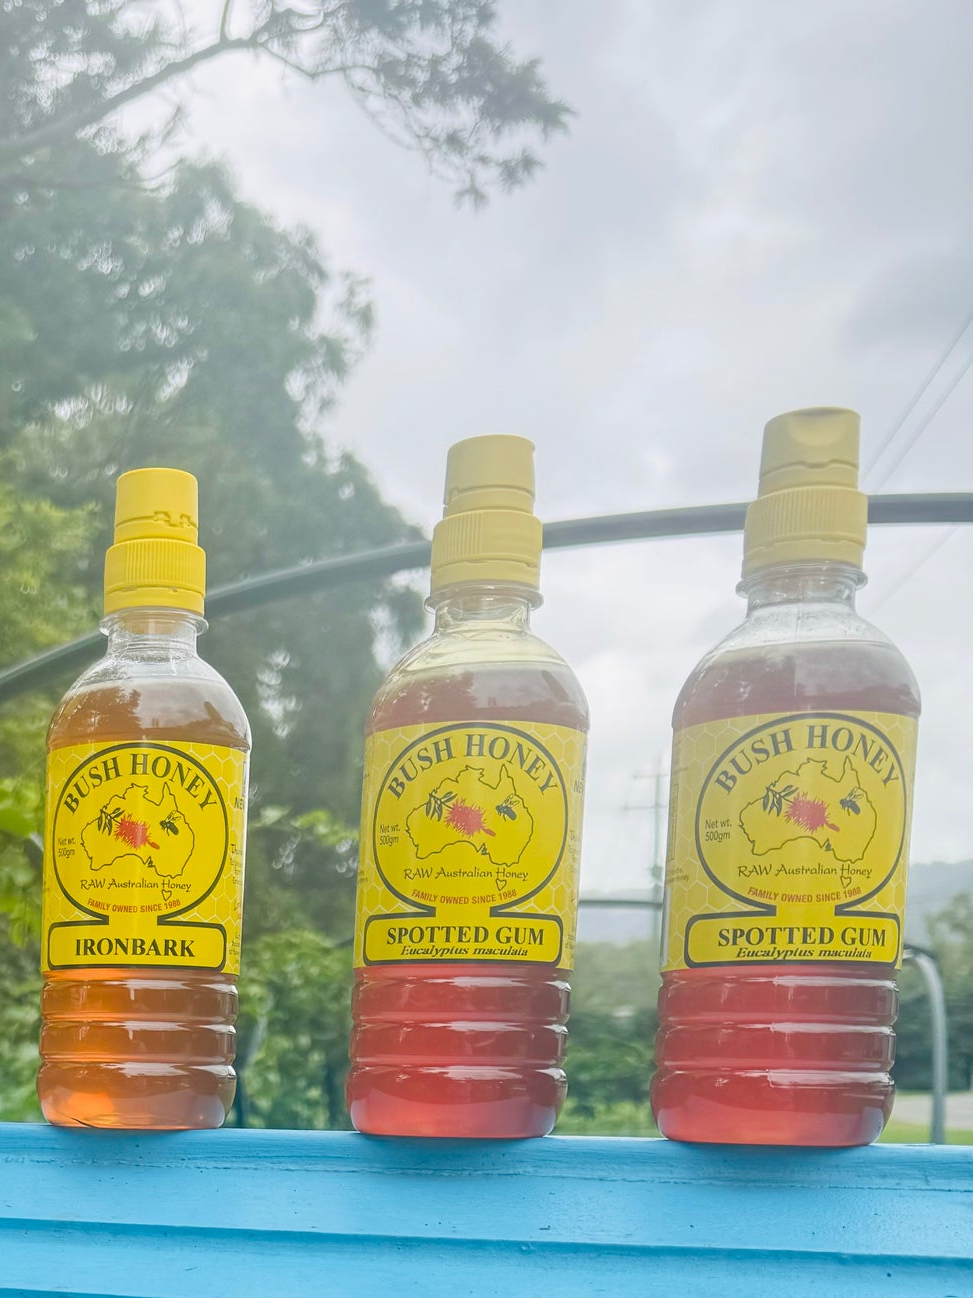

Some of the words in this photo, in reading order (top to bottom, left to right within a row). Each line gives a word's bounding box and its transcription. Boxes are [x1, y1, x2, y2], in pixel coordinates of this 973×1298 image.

[387, 736, 456, 800] BUSH
[465, 734, 559, 795] HONEY
[714, 728, 794, 795] BUSH
[805, 724, 899, 788] HONEY
[63, 757, 123, 816] BUSH
[129, 753, 218, 811] HONEY
[379, 824, 391, 834] Net
[705, 819, 719, 830] Net
[720, 818, 732, 828] wt.
[379, 835, 399, 847] 500gm
[705, 830, 731, 843] 500gm
[404, 868, 433, 880] RAW
[435, 867, 493, 879] Australian
[495, 868, 529, 882] Honey
[738, 864, 772, 877] RAW
[775, 863, 837, 876] Australian
[840, 863, 873, 879] Honey
[80, 878, 106, 890] RAW
[107, 878, 159, 890] Australian
[161, 879, 192, 892] Honey
[411, 889, 438, 903] FAMILY
[440, 895, 469, 905] OWNED
[471, 894, 497, 904] SINCE
[498, 889, 517, 901] 1988
[747, 886, 779, 901] FAMILY
[781, 893, 813, 903] OWNED
[816, 892, 842, 902] SINCE
[843, 887, 861, 899] 1988
[87, 898, 111, 911] FAMILY
[112, 904, 137, 913] OWNED
[140, 903, 162, 913] SINCE
[386, 926, 489, 945] SPOTTED
[496, 926, 544, 946] GUM
[718, 927, 835, 947] SPOTTED
[841, 926, 886, 947] GUM
[75, 937, 196, 958] IRONBARK
[400, 945, 470, 957] Eucalyptus
[472, 946, 528, 957] maculata
[736, 947, 814, 960] Eucalyptus
[818, 948, 872, 959] maculata
